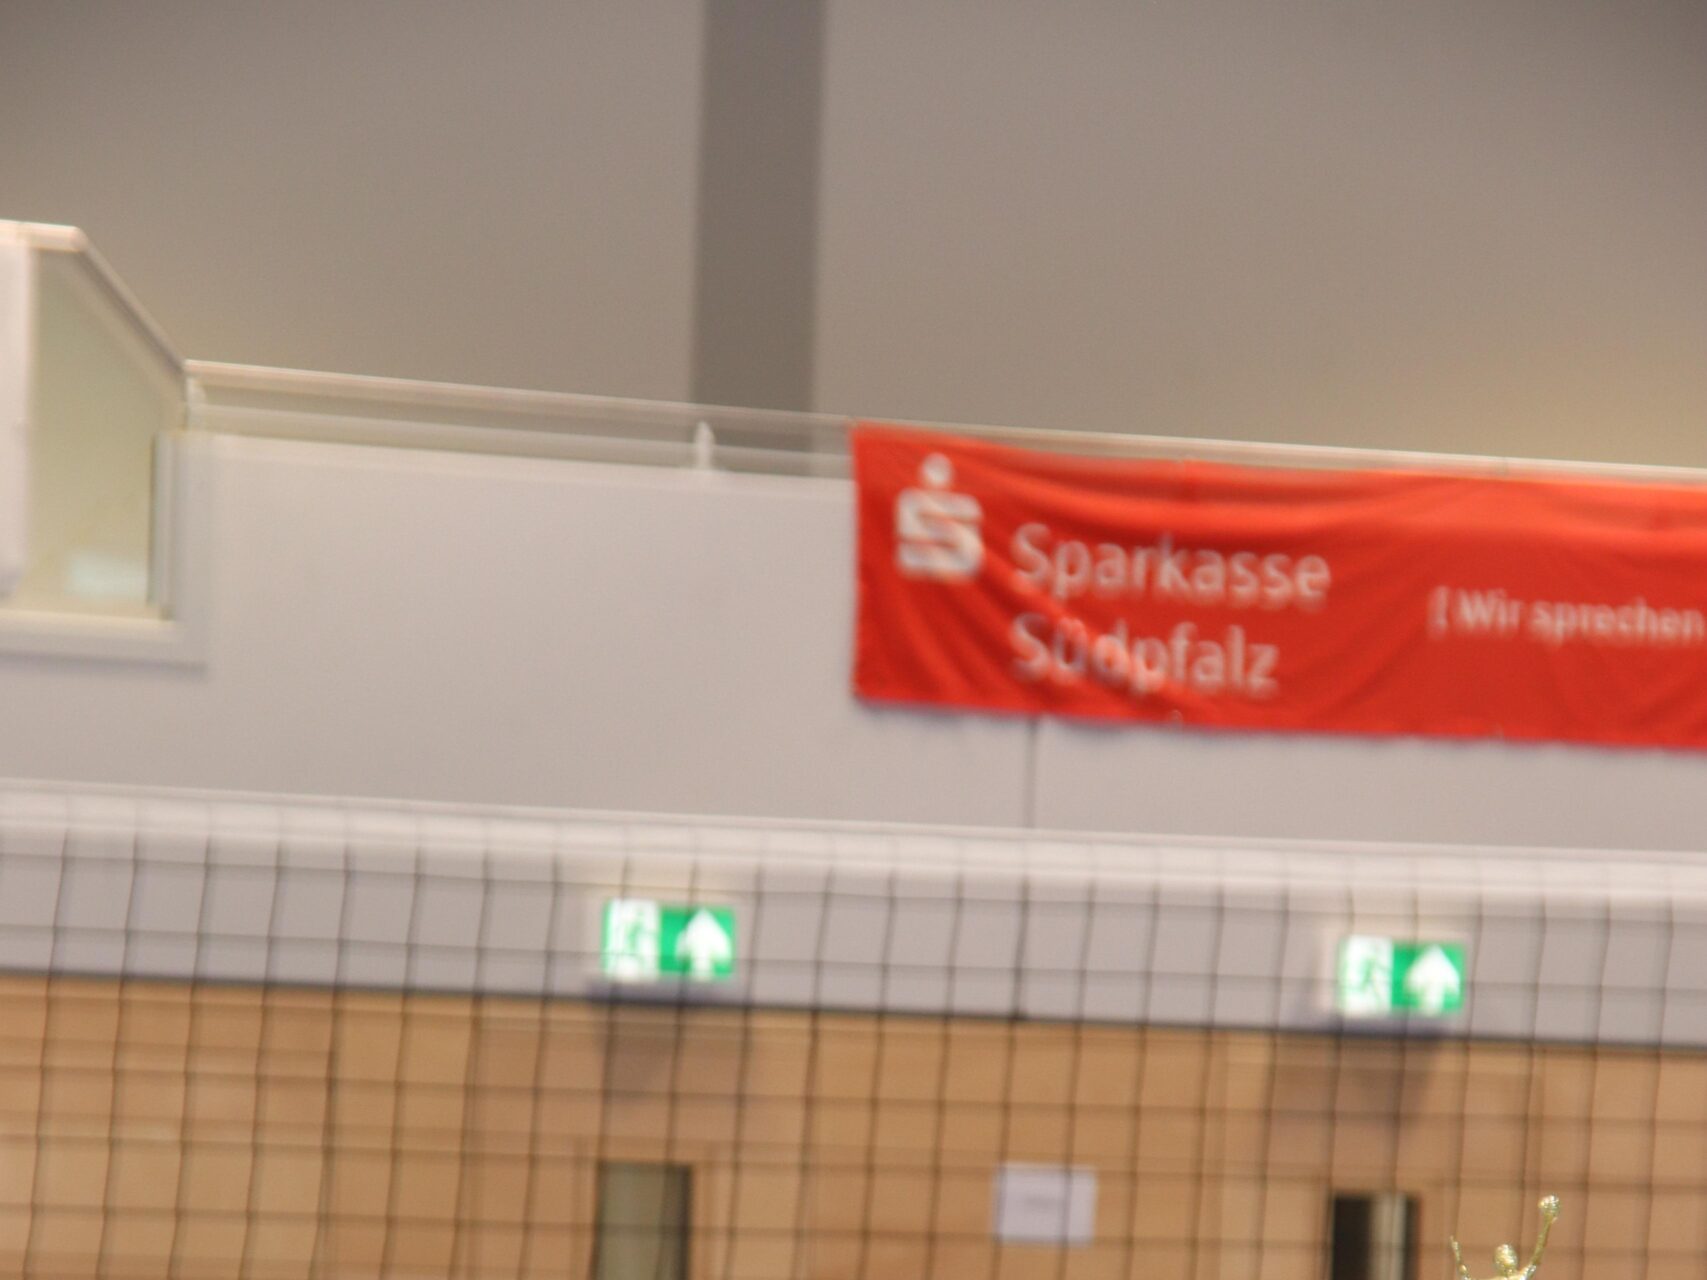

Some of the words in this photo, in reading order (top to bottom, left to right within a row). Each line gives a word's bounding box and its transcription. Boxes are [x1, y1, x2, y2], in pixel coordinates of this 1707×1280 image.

[1010, 520, 1331, 608] Sparkasse
[1011, 612, 1279, 699] Südpfalz
[1455, 587, 1523, 632] Wir
[1530, 595, 1706, 646] sprechen
